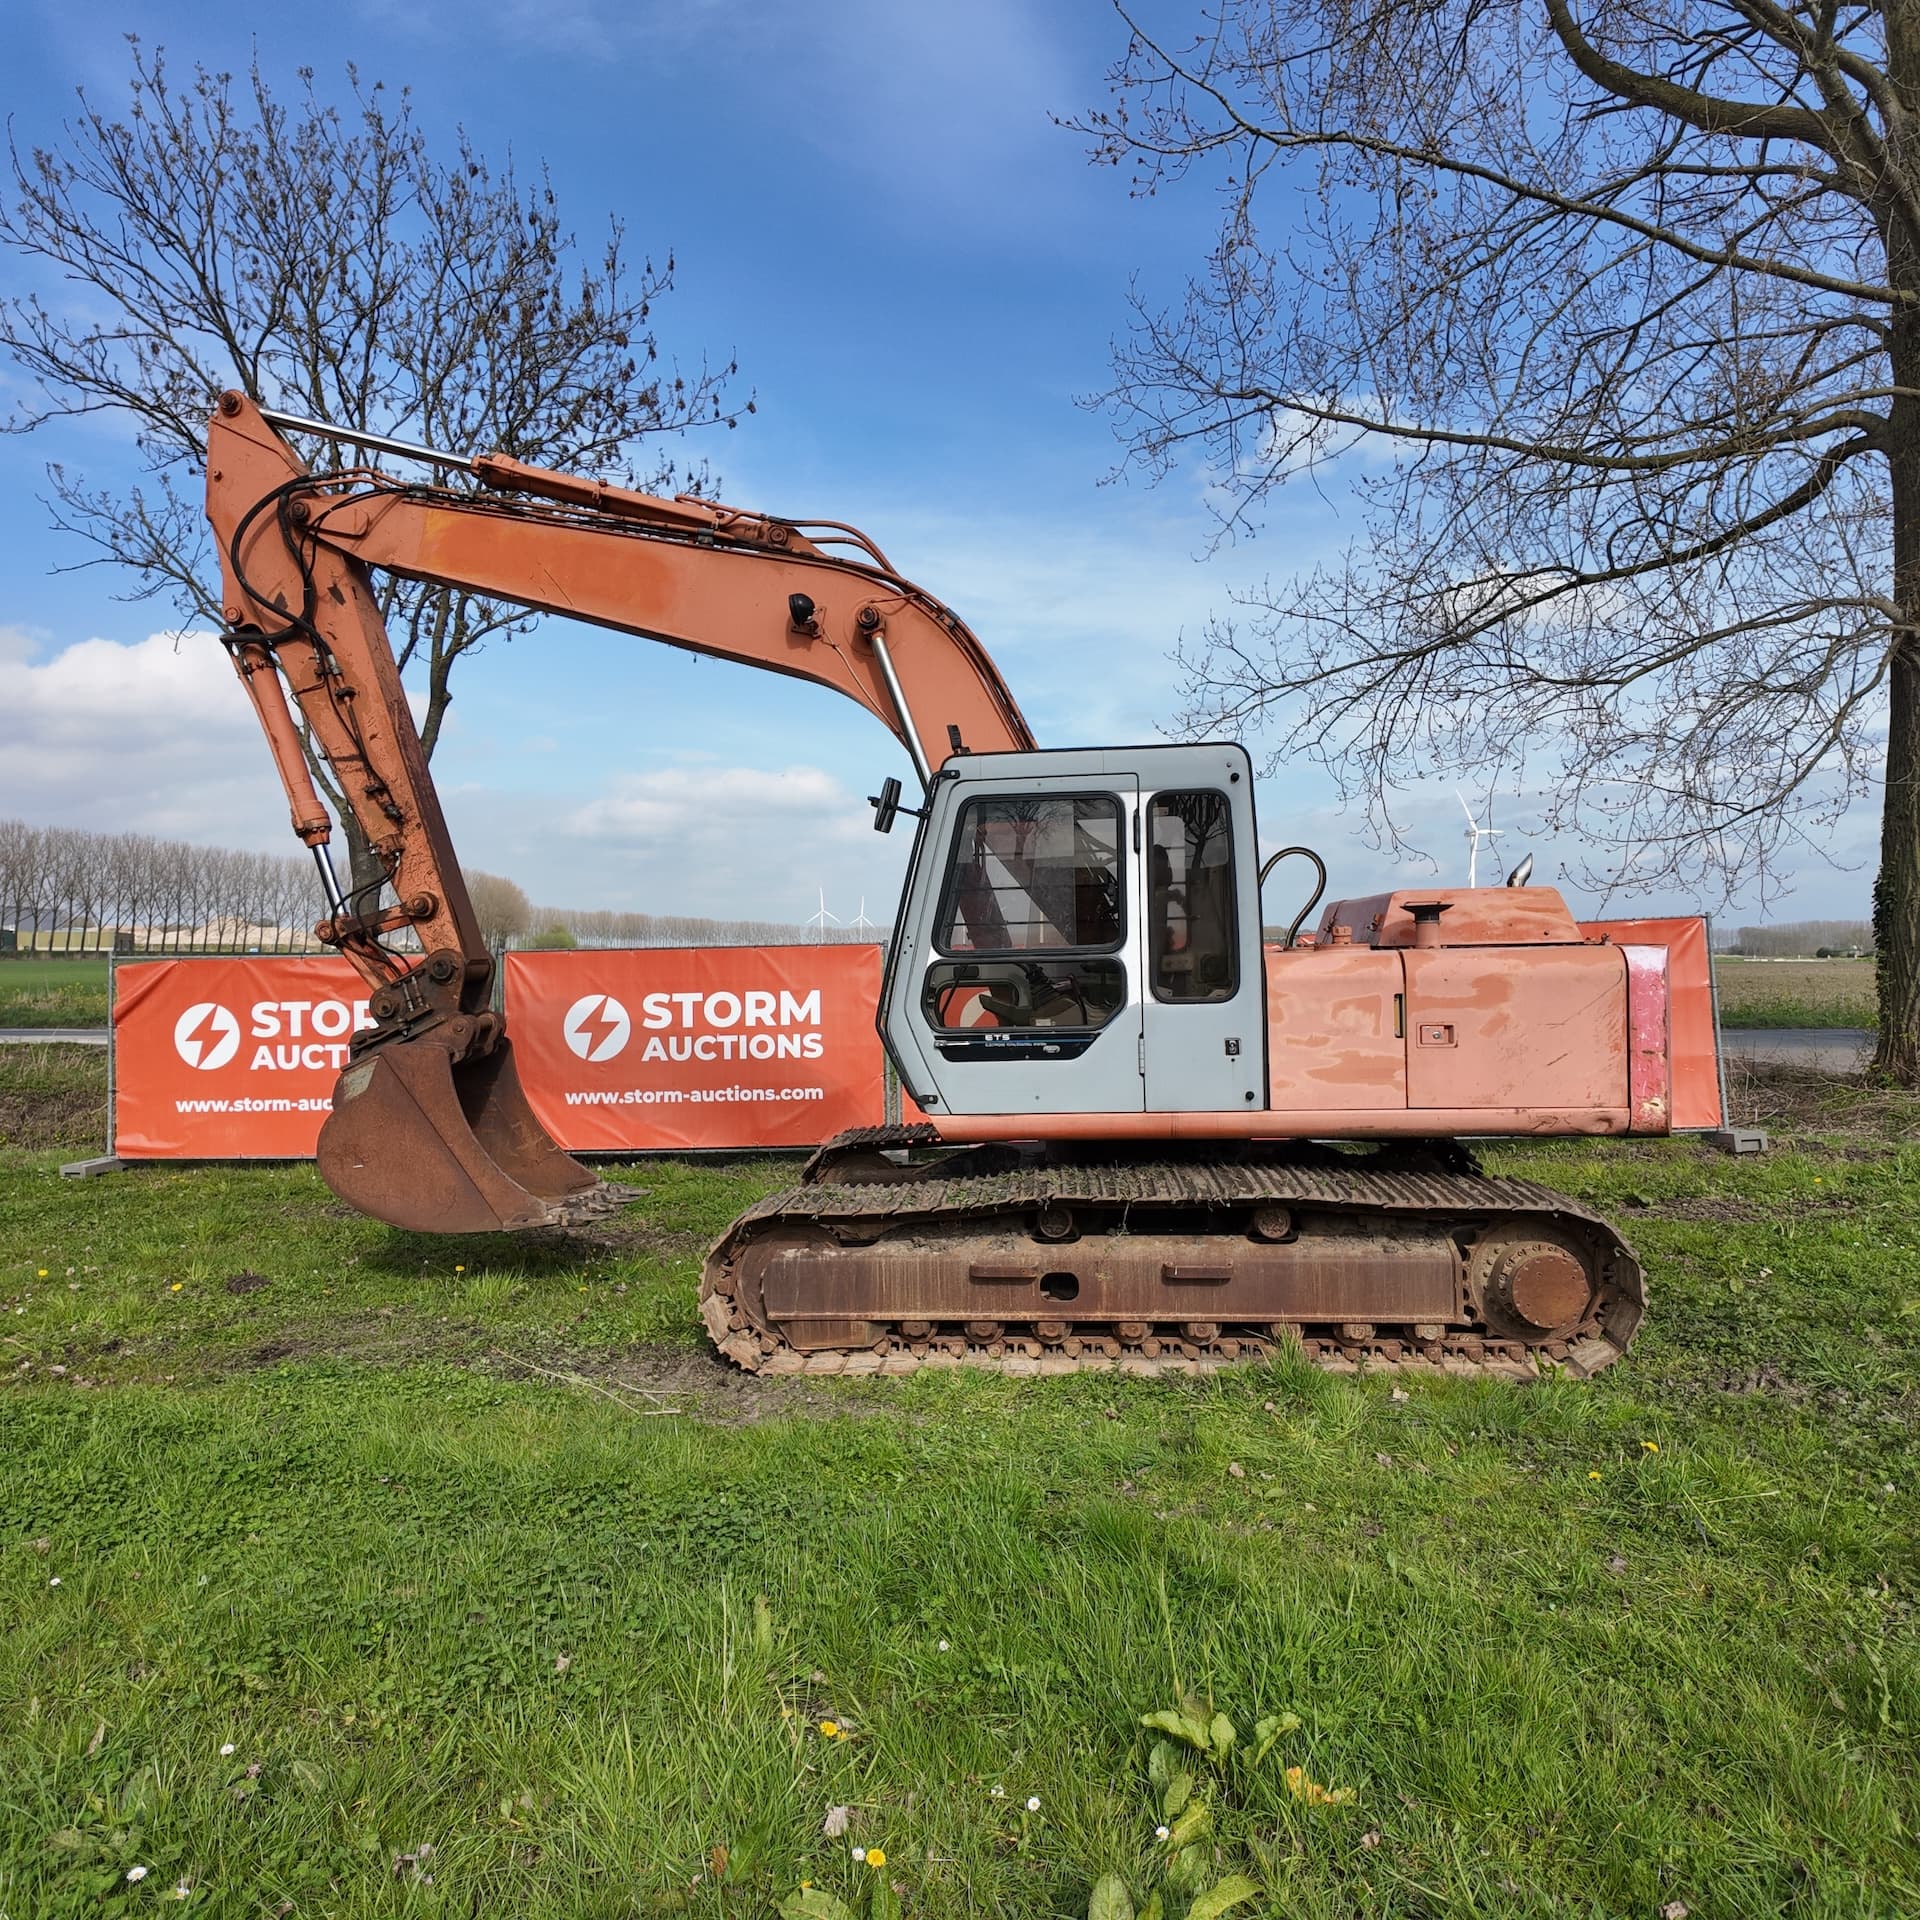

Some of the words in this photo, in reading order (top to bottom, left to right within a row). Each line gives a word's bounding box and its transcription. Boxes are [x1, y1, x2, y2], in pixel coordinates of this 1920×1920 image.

[642, 990, 821, 1030] STORM
[641, 1033, 824, 1062] AUCTIONS
[175, 1097, 334, 1113] www.storm-auc
[565, 1085, 824, 1105] www.storm-auctions.com
